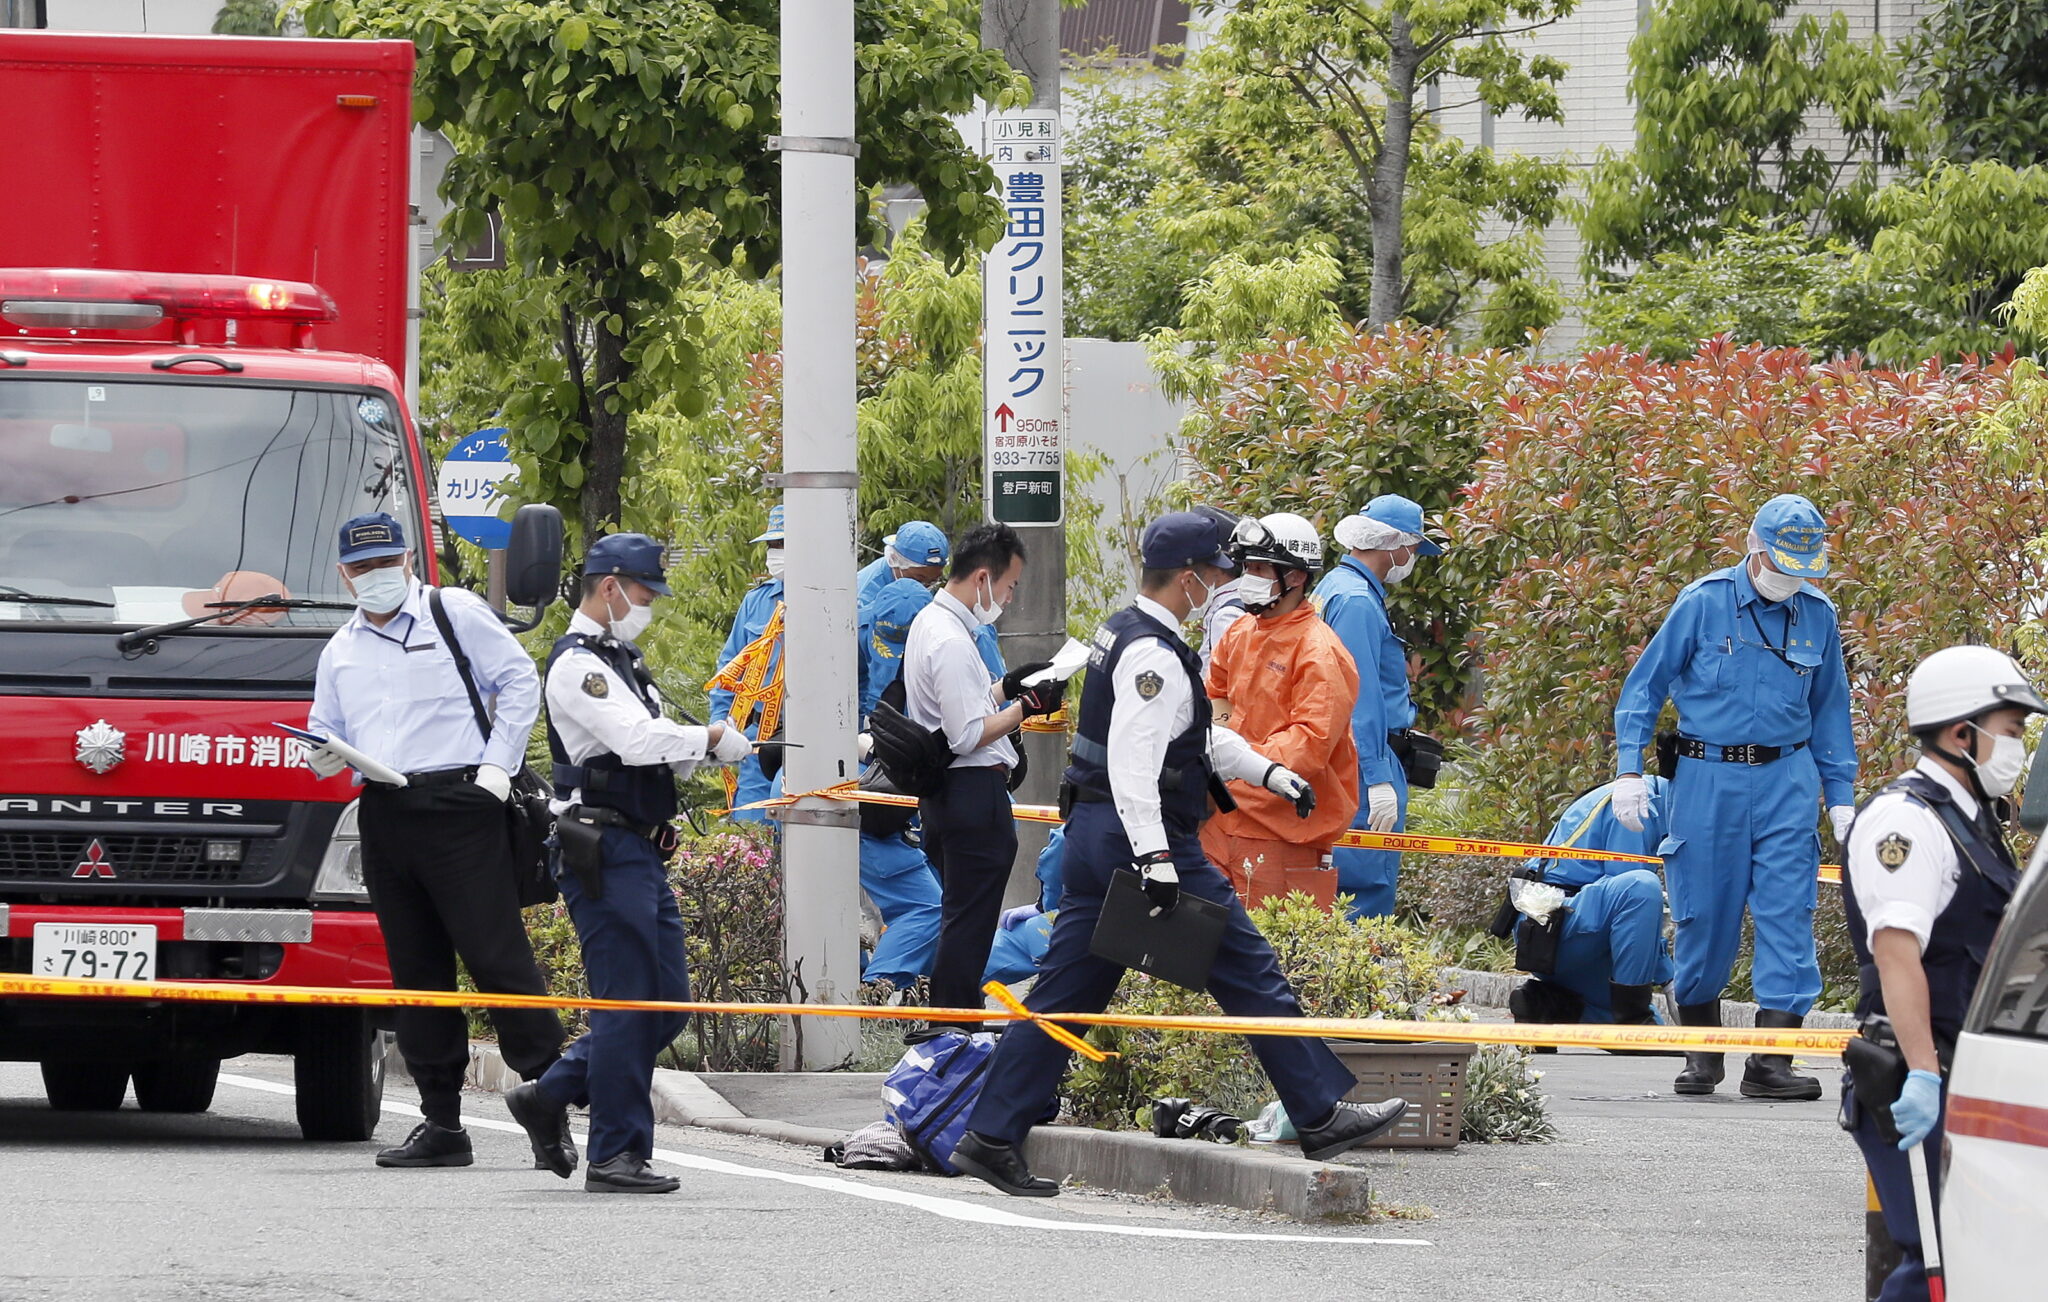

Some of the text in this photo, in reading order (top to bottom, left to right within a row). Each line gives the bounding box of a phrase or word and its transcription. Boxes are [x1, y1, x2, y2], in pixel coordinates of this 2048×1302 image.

[998, 121, 1051, 137] 小児科
[1007, 171, 1047, 398] 豊田クリニック
[993, 451, 1060, 465] 933-7755
[446, 479, 513, 500] カリタ
[1002, 481, 1053, 495] 登戸新町
[1275, 538, 1321, 555] 川崎消防
[144, 732, 313, 768] 川崎市消防
[0, 799, 243, 816] ANTER
[1383, 837, 1430, 849] POLICE
[1523, 848, 1558, 857] KEEP
[63, 929, 129, 946] 川崎 800
[43, 949, 149, 981] さ 79-72
[1615, 1031, 1656, 1042] KEEP
[1657, 1032, 1688, 1044] OUT
[1795, 1036, 1849, 1049] POLICE
